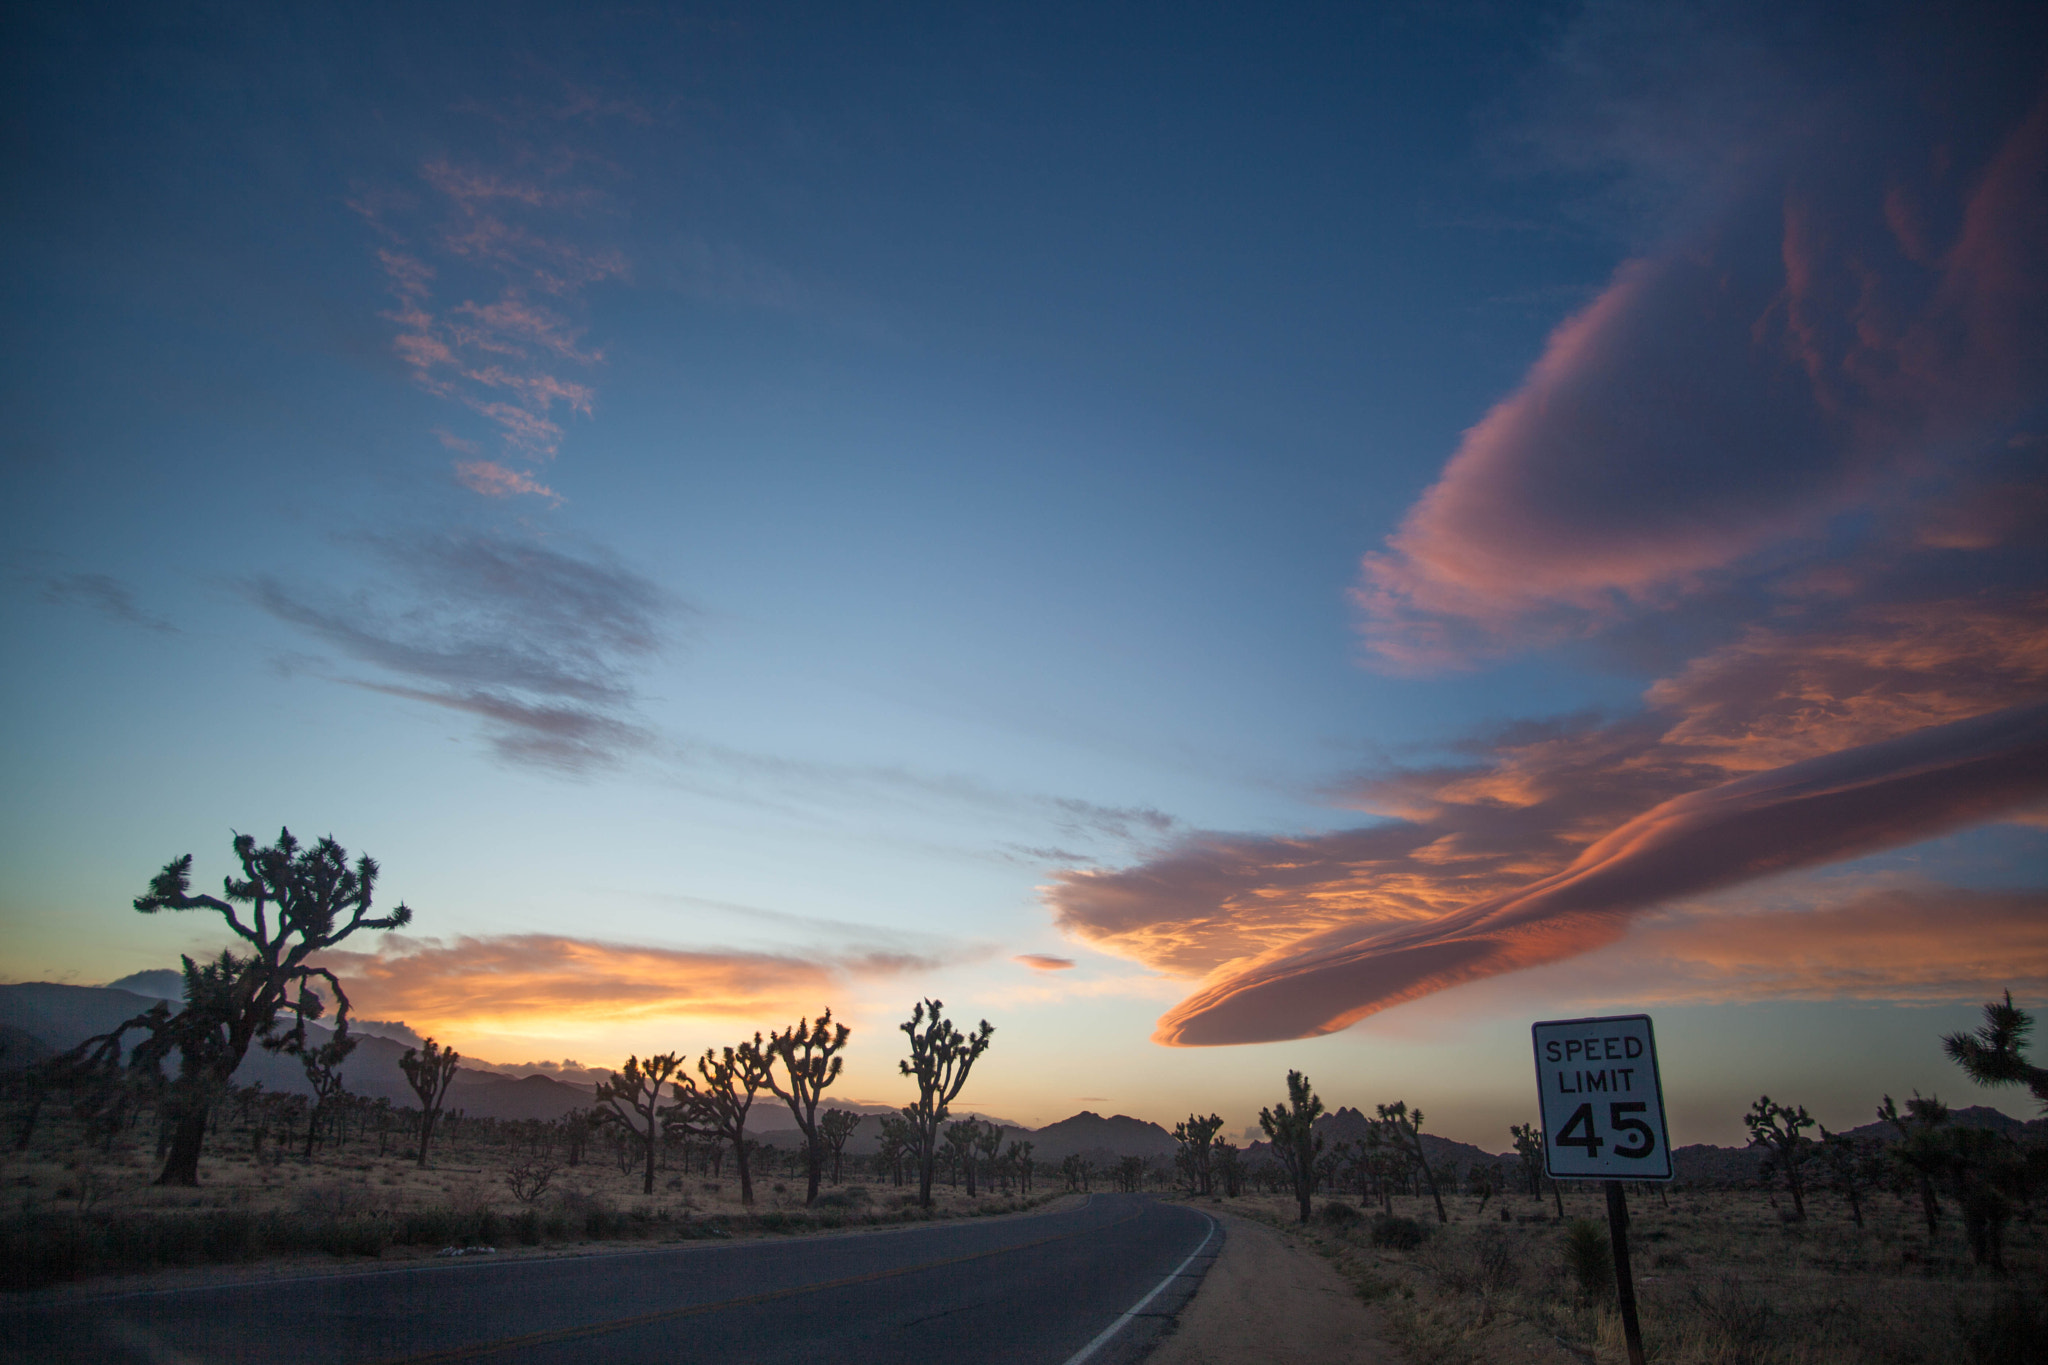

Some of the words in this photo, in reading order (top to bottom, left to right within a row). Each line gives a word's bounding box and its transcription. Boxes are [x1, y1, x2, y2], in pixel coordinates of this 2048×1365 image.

[1546, 1036, 1643, 1062] SPEED
[1558, 1068, 1634, 1093] LIMIT
[1555, 1102, 1655, 1159] 45
